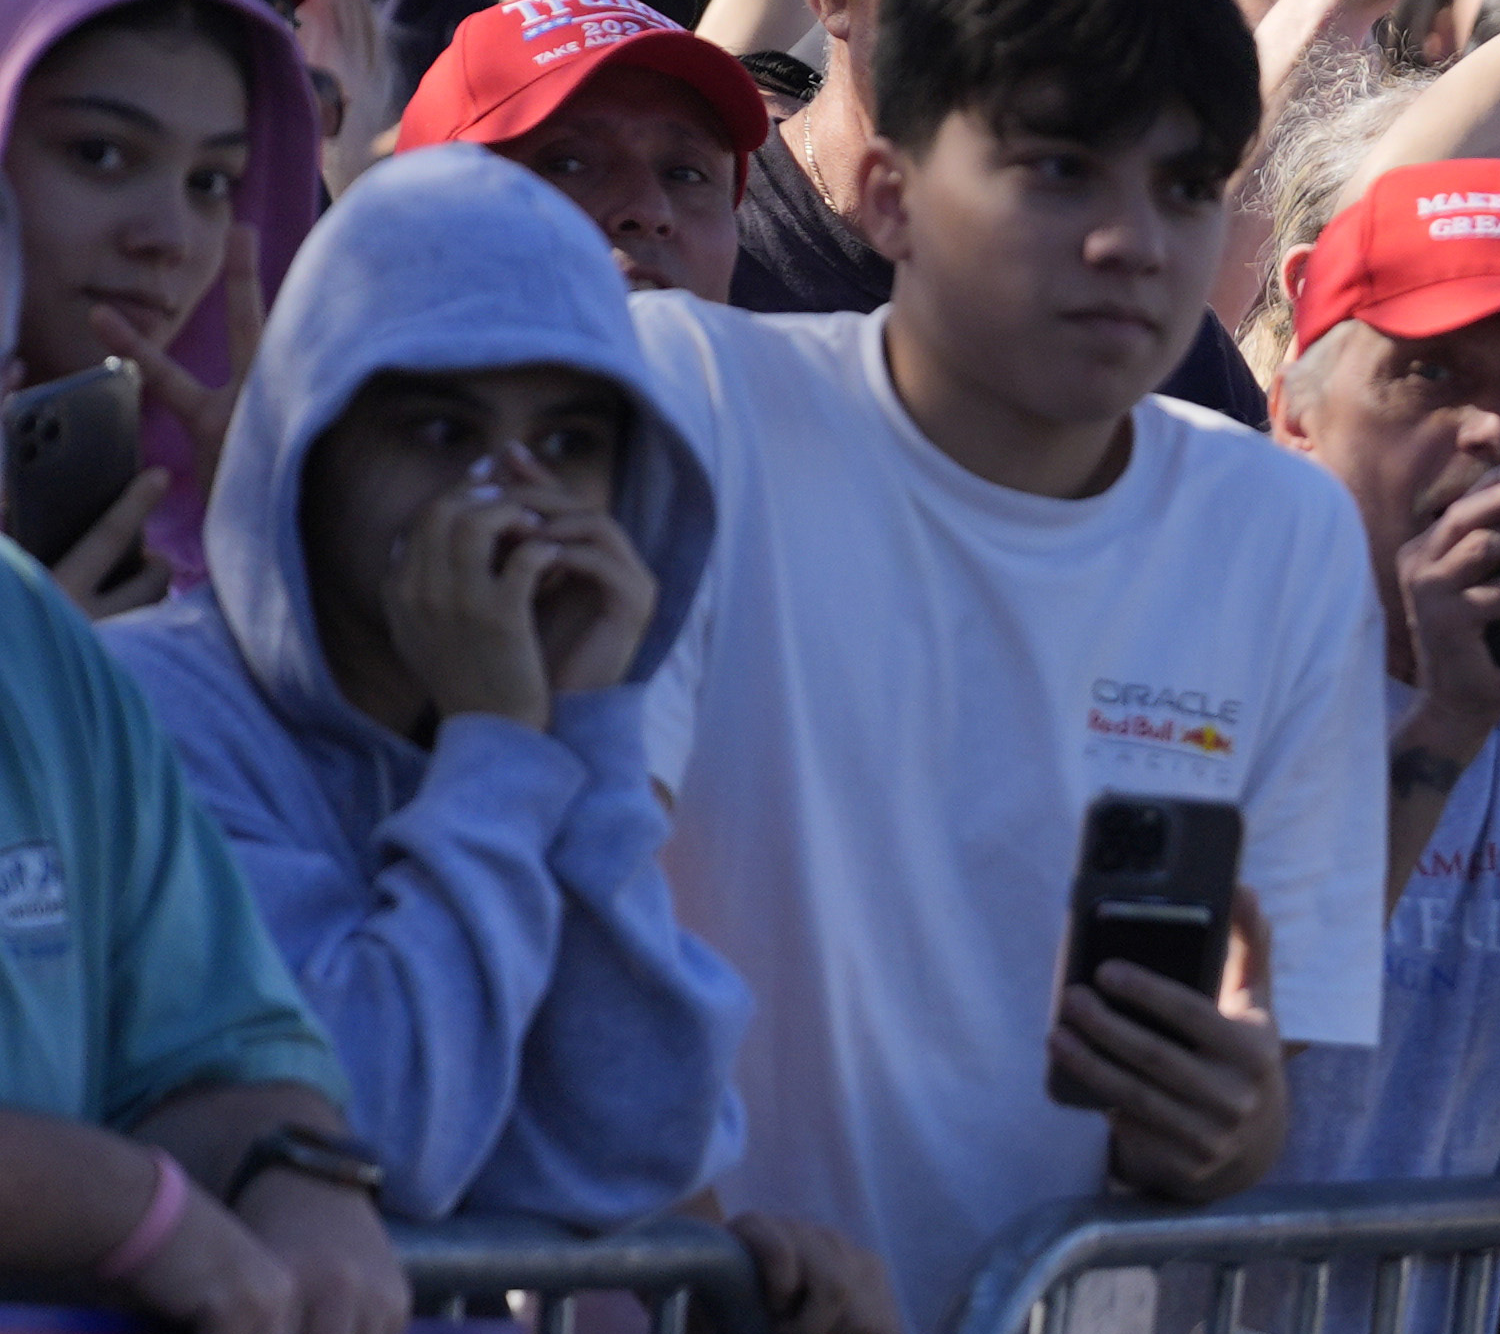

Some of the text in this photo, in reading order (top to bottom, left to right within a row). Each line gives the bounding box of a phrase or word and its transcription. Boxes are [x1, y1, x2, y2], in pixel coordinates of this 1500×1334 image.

[581, 18, 643, 41] 202
[532, 41, 581, 65] TAKE
[1091, 678, 1243, 726] ORACLE
